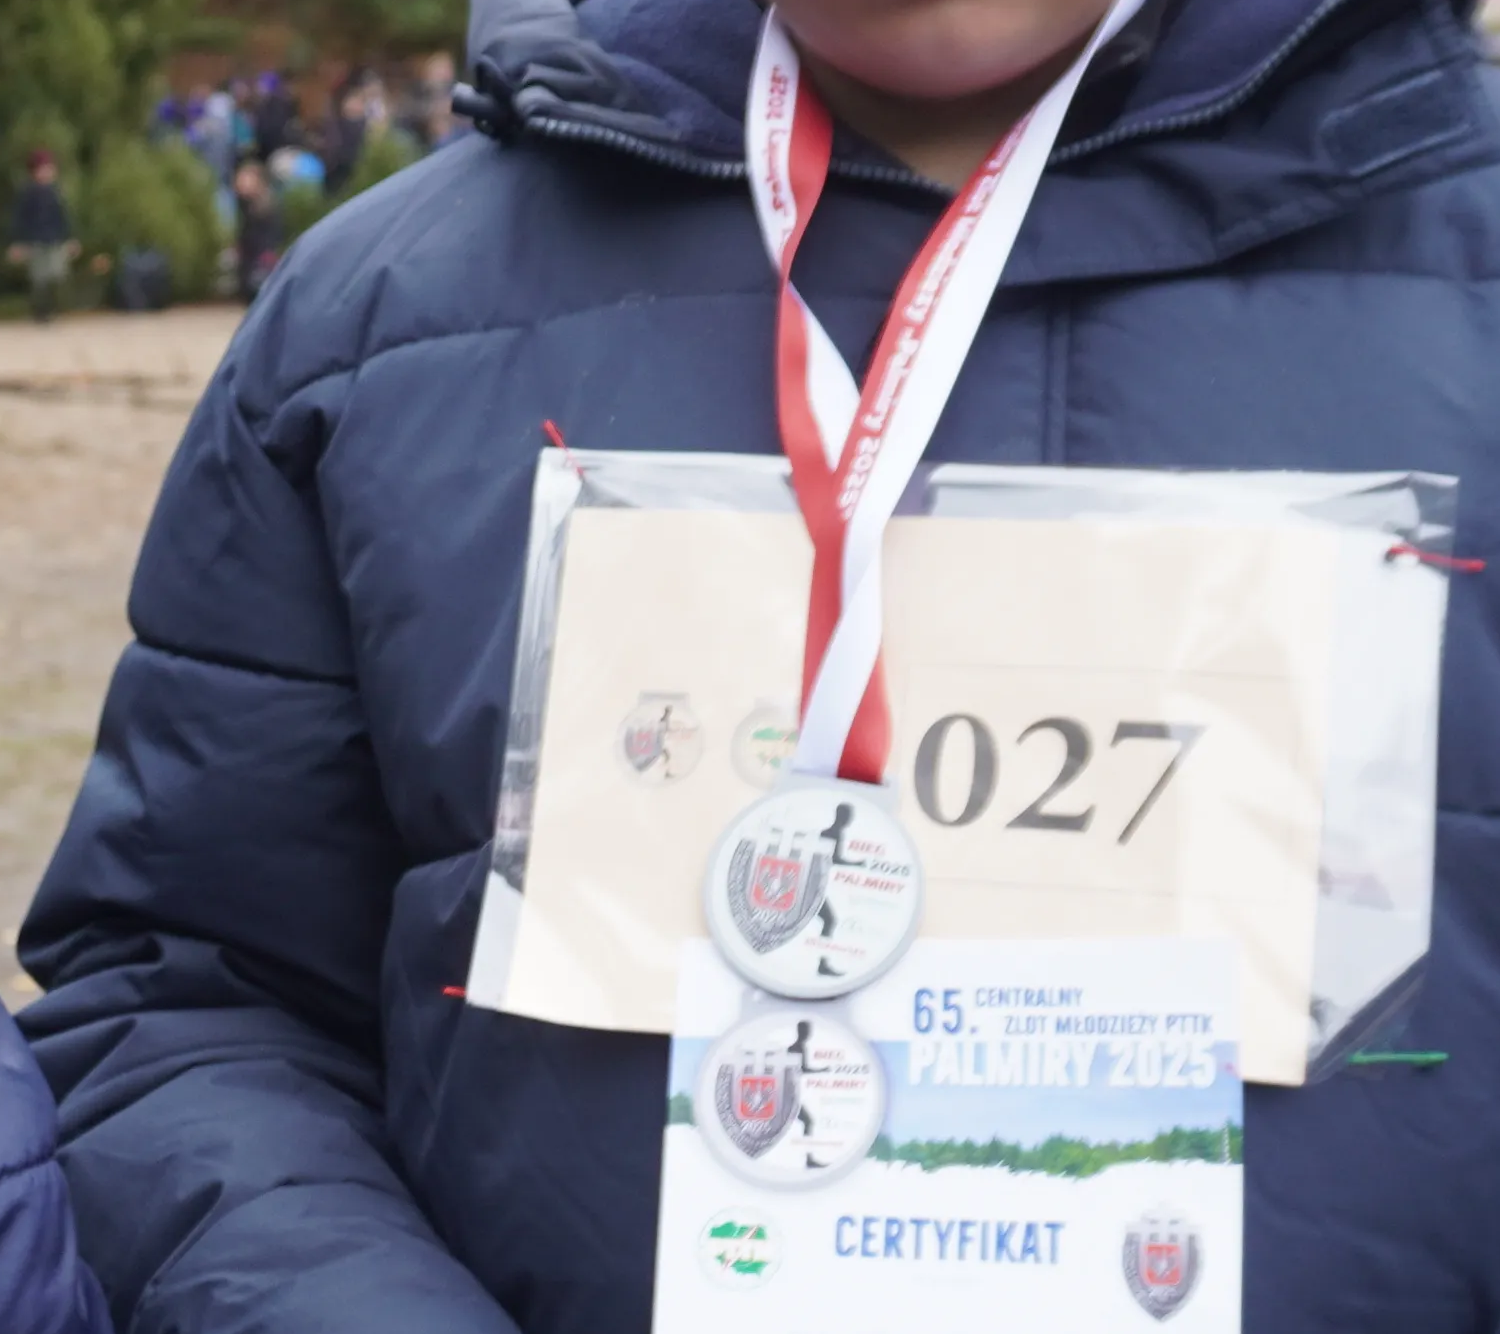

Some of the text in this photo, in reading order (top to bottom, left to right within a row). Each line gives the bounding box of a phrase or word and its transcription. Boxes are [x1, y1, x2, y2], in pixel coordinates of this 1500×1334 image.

[912, 712, 1210, 846] 027
[913, 986, 1084, 1036] 65. CENTRALNY
[1003, 1014, 1049, 1036] ZLOT
[1164, 1013, 1215, 1035] PTTK
[908, 1040, 1218, 1089] PALMIRY 2025
[834, 1216, 1067, 1265] CERTYFIKAT
